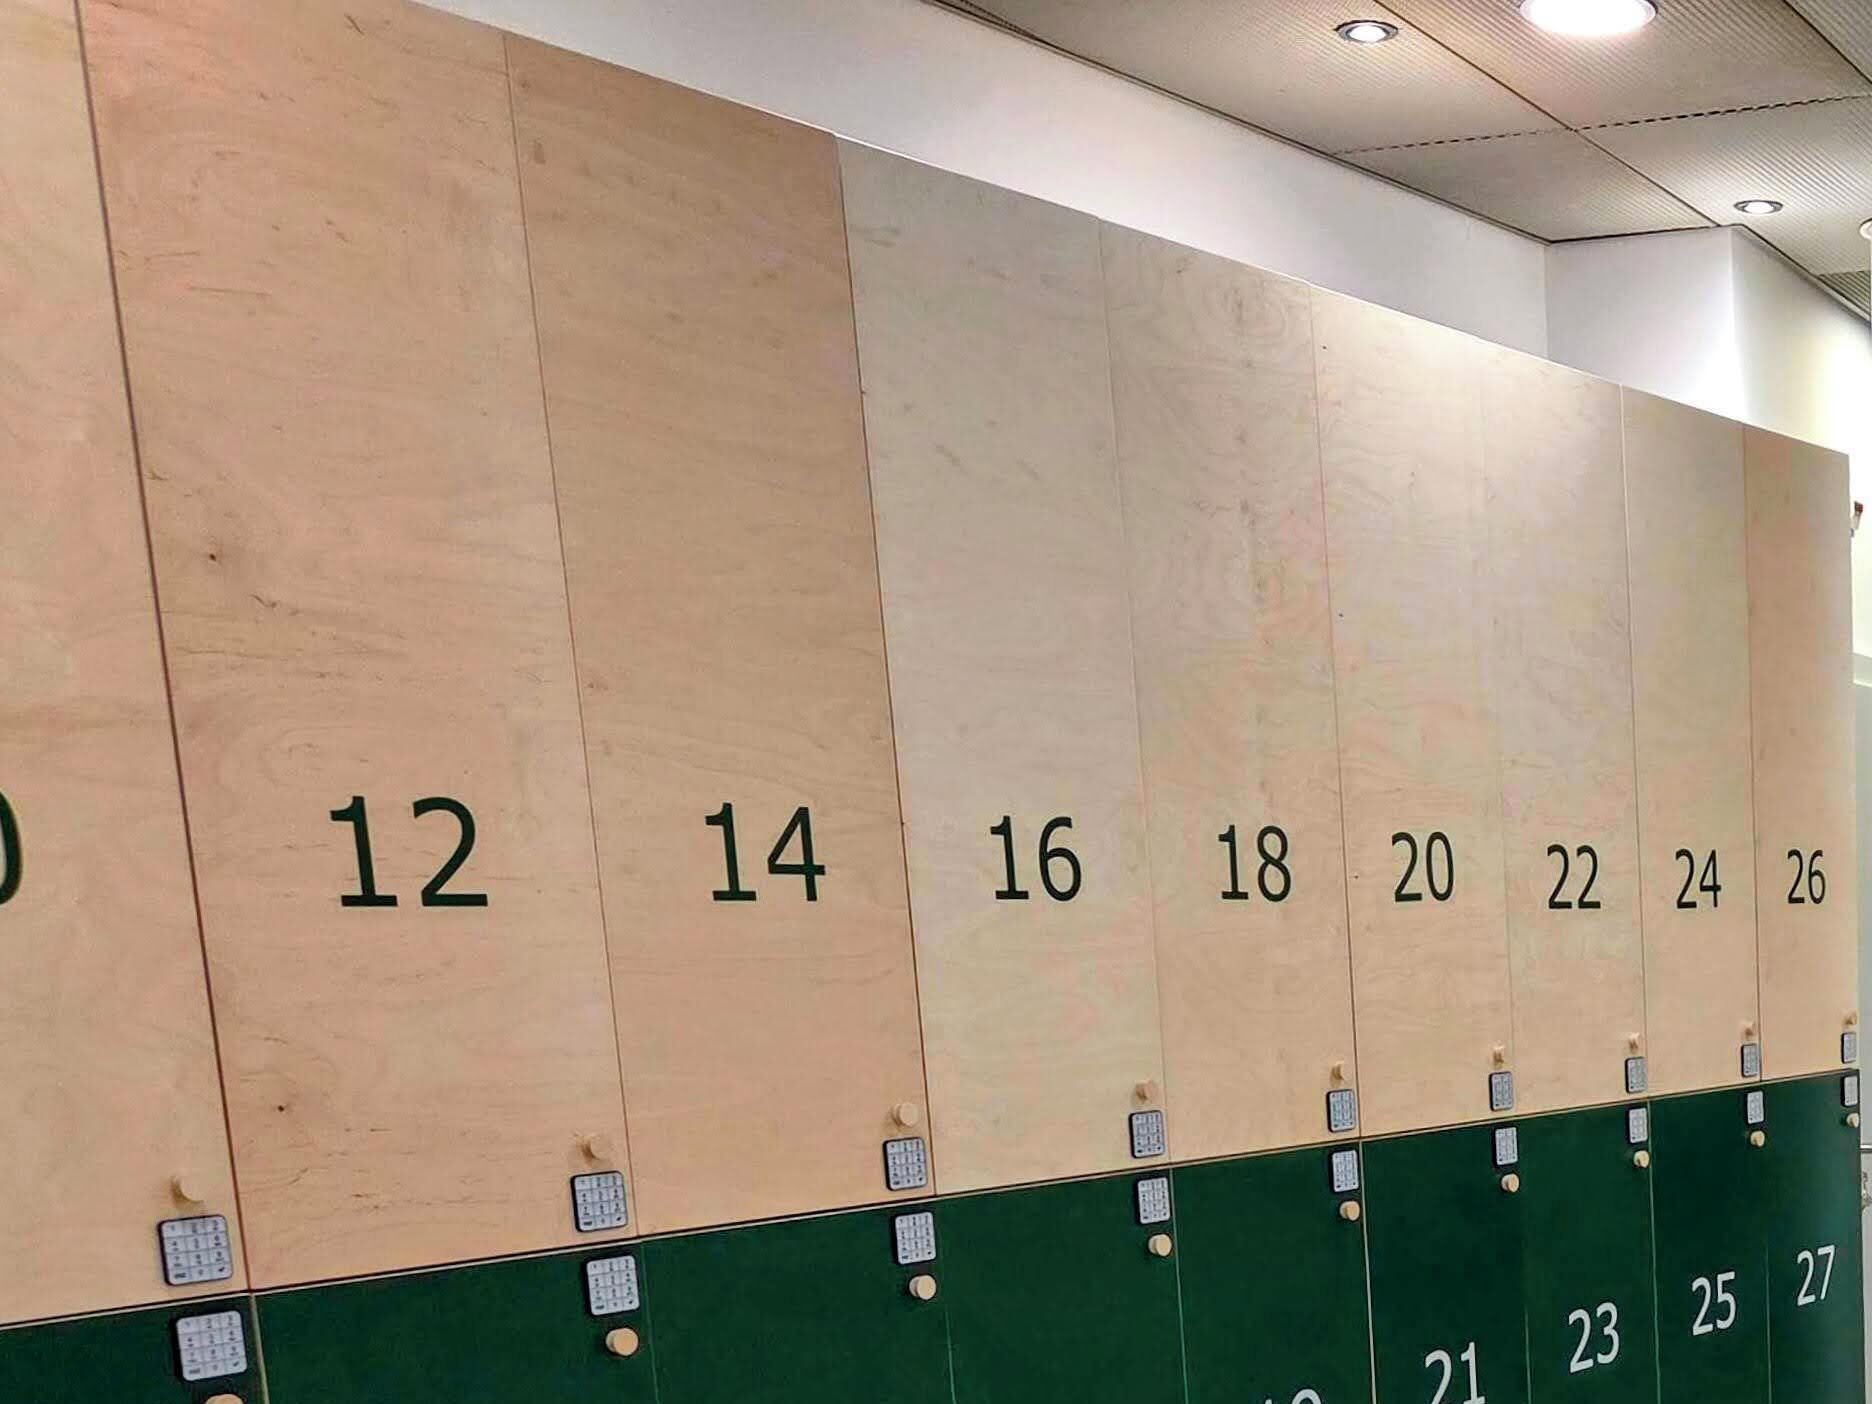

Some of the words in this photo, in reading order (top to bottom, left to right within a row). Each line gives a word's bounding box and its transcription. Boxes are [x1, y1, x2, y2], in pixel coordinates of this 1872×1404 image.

[329, 795, 489, 907] 12
[705, 802, 826, 902] 14
[990, 815, 1082, 902] 16
[1218, 824, 1292, 903] 18
[1391, 831, 1454, 903] 20
[1547, 844, 1601, 910] 22
[1675, 848, 1722, 909] 24
[1787, 849, 1826, 905] 26
[1692, 1271, 1736, 1336] 25
[1797, 1244, 1835, 1306] 27
[1568, 1302, 1620, 1373] 23
